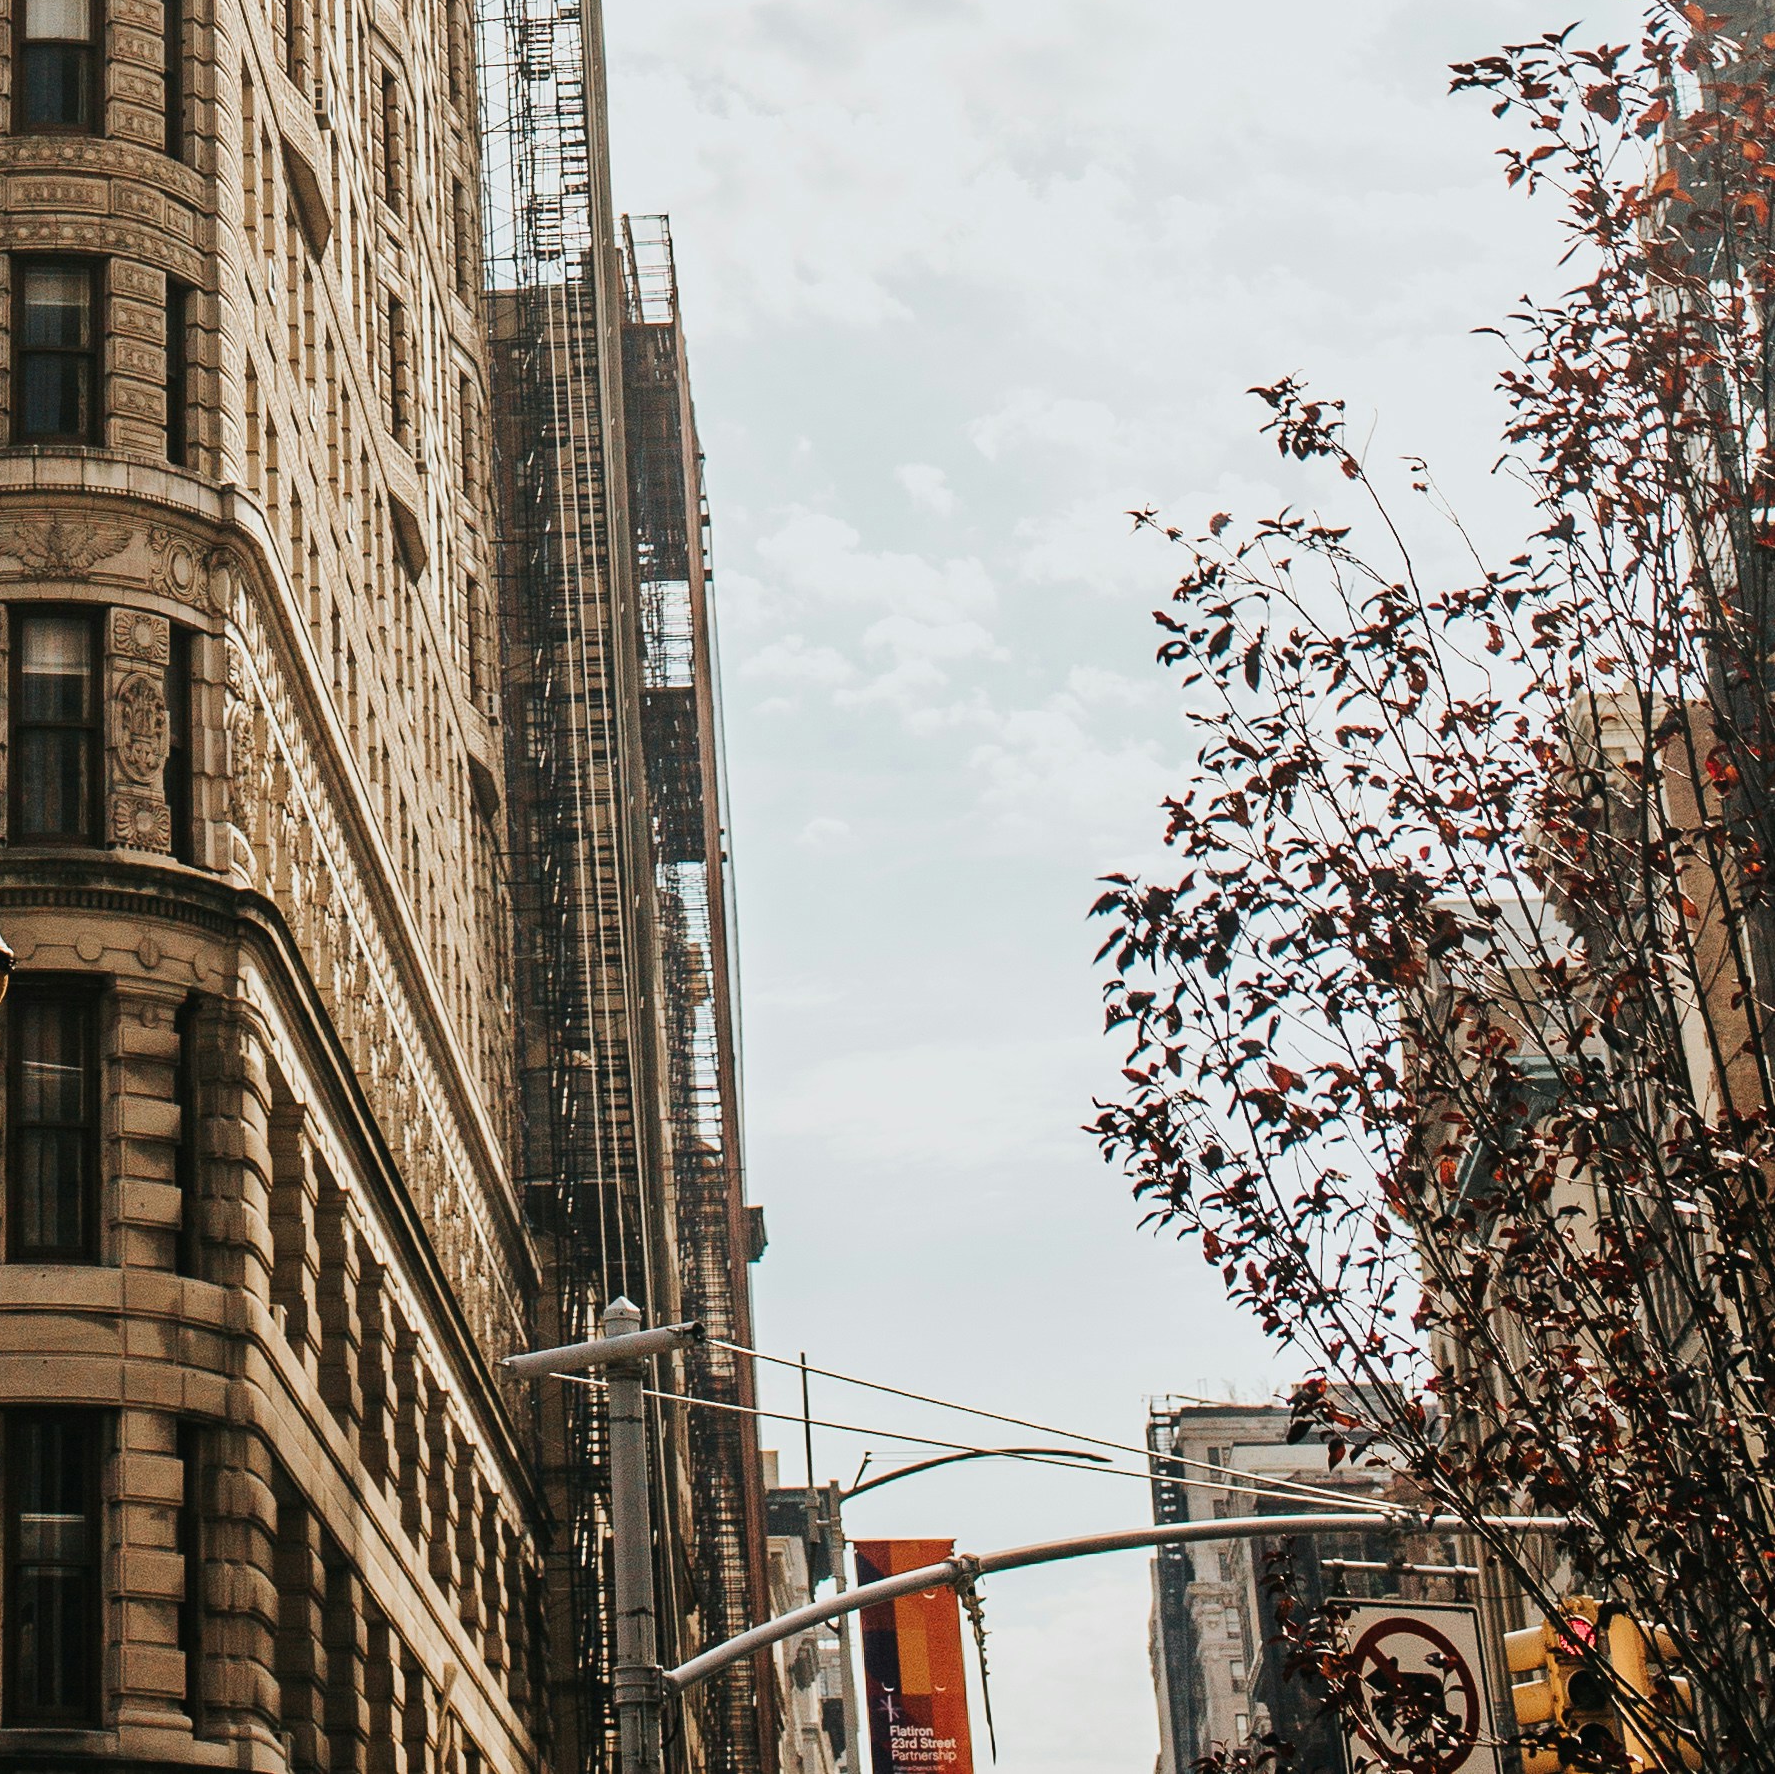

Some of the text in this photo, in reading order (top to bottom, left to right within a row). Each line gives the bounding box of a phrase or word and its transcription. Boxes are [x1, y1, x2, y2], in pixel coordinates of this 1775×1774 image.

[889, 1725, 934, 1736] Flatiron
[891, 1737, 957, 1749] 23rd Street
[892, 1749, 957, 1763] Partnership
